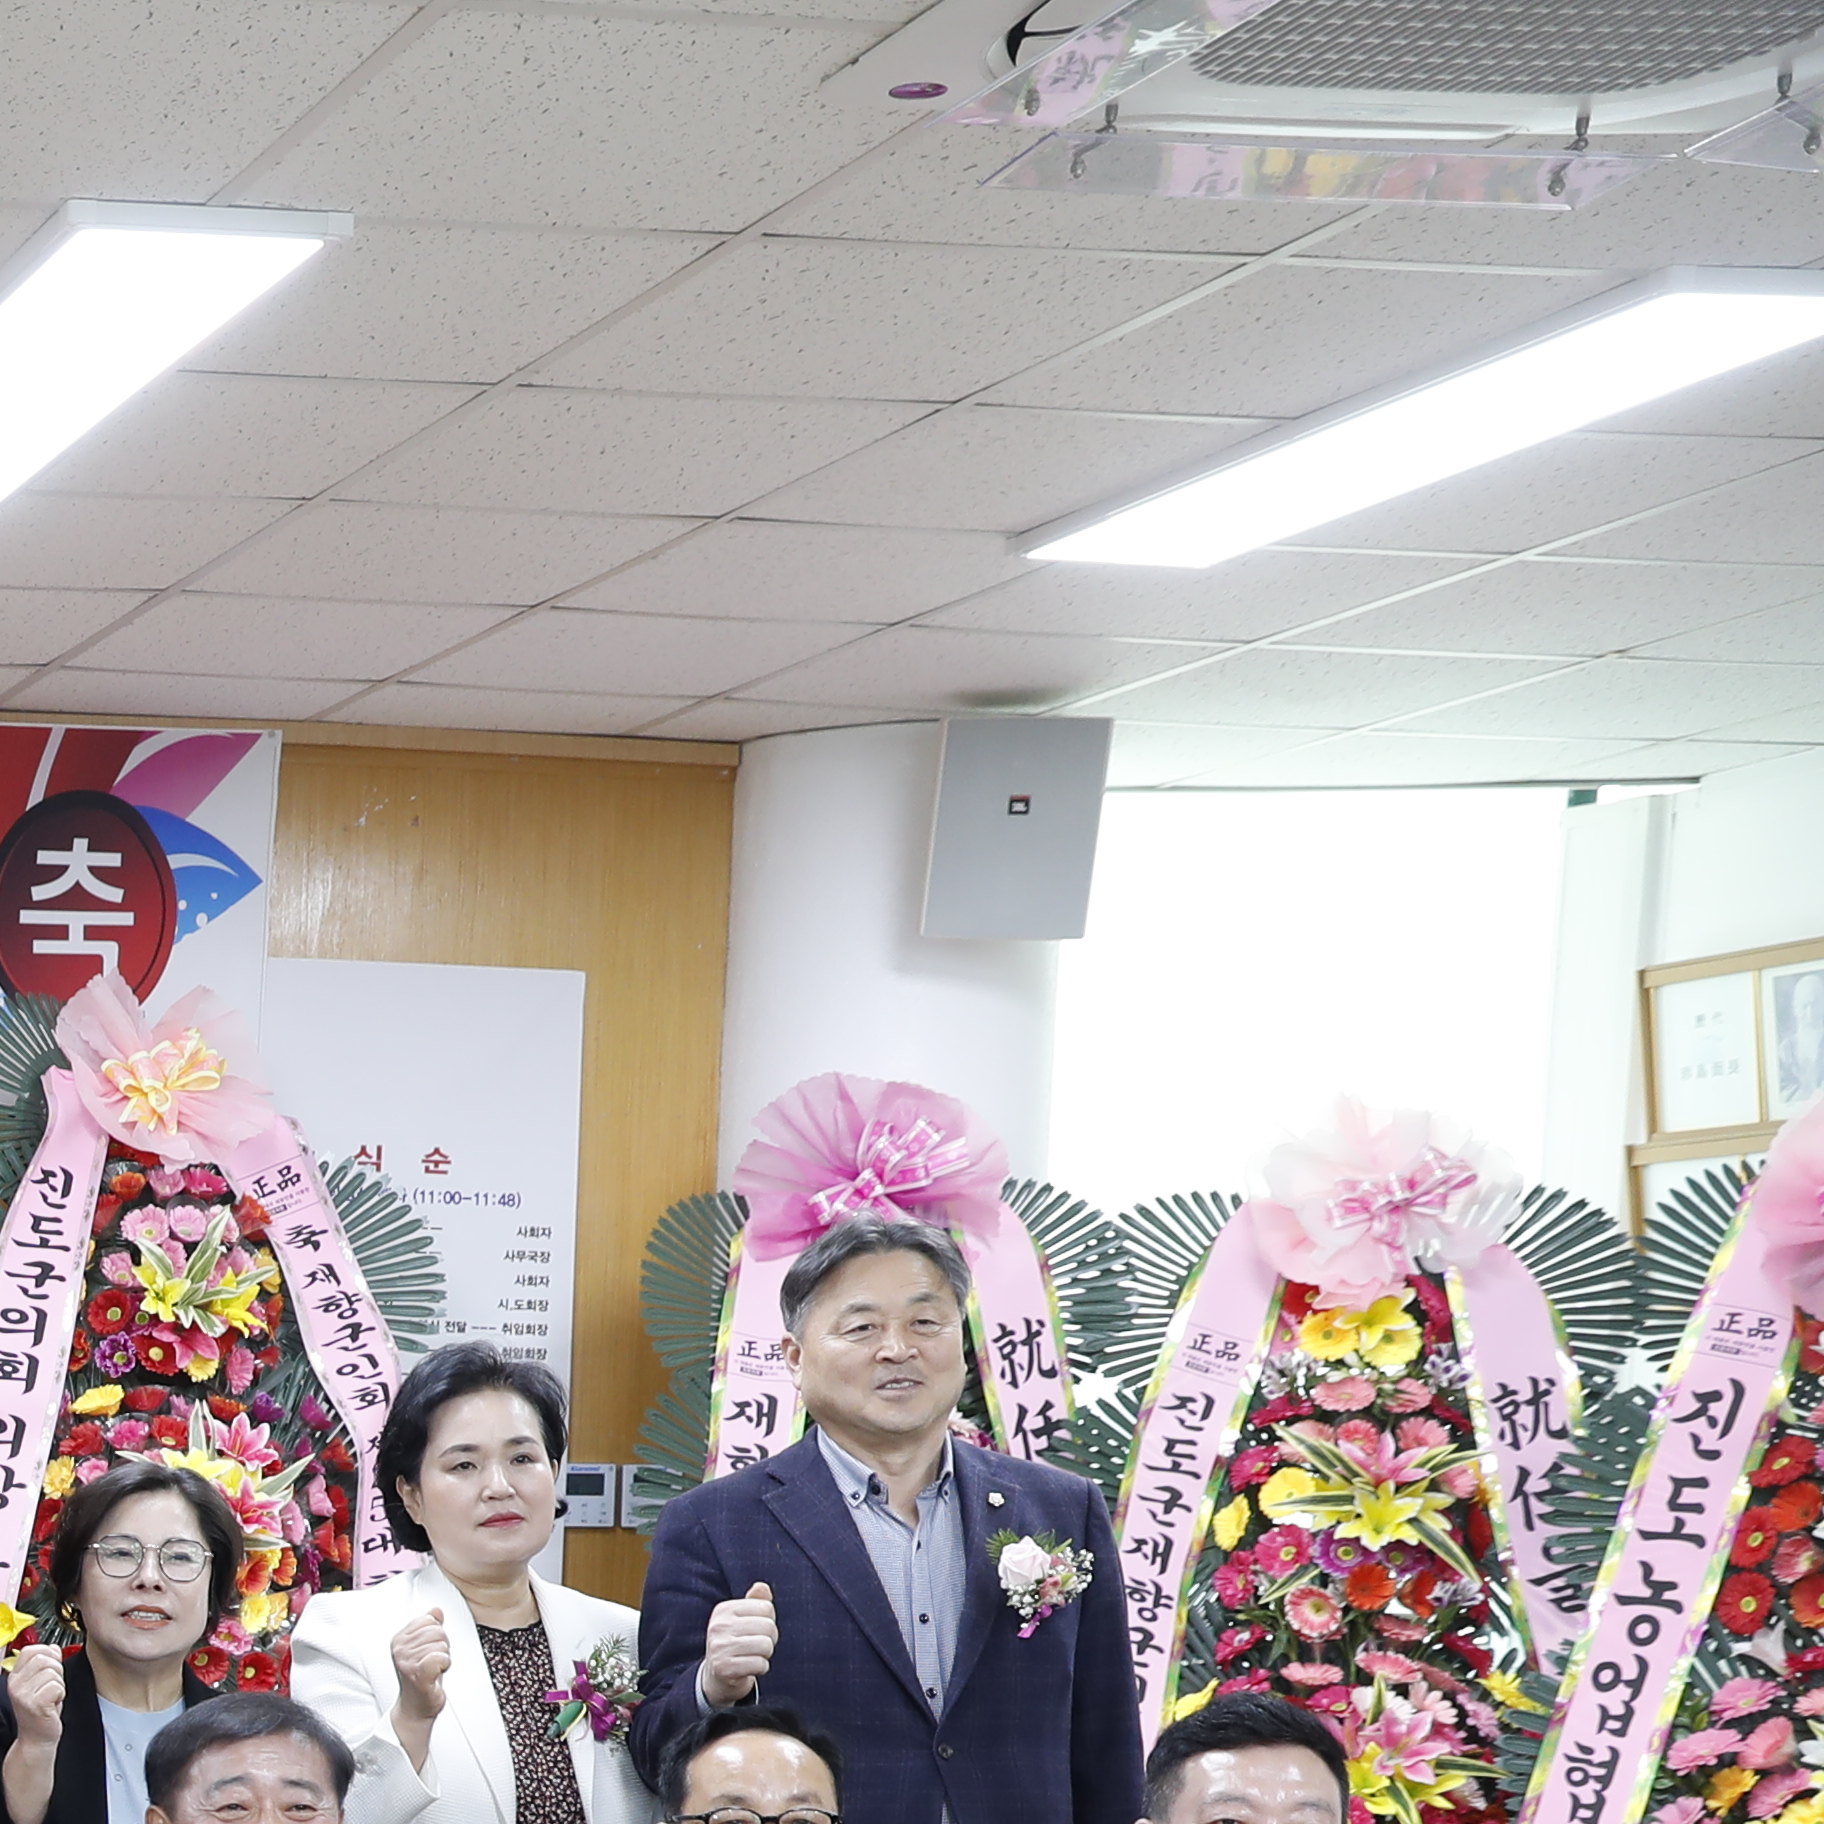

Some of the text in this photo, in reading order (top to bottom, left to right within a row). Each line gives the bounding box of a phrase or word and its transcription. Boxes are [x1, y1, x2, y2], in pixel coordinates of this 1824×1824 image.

[19, 838, 134, 977] 축
[413, 1187, 522, 1210] (11:00-11:48)
[516, 1226, 552, 1239] 사회자
[503, 1249, 551, 1263] 사무국장
[514, 1274, 550, 1288] 사회자
[501, 1322, 548, 1336] 취임회장
[1711, 1311, 1778, 1341] 正品
[1186, 1333, 1242, 1362] 正品
